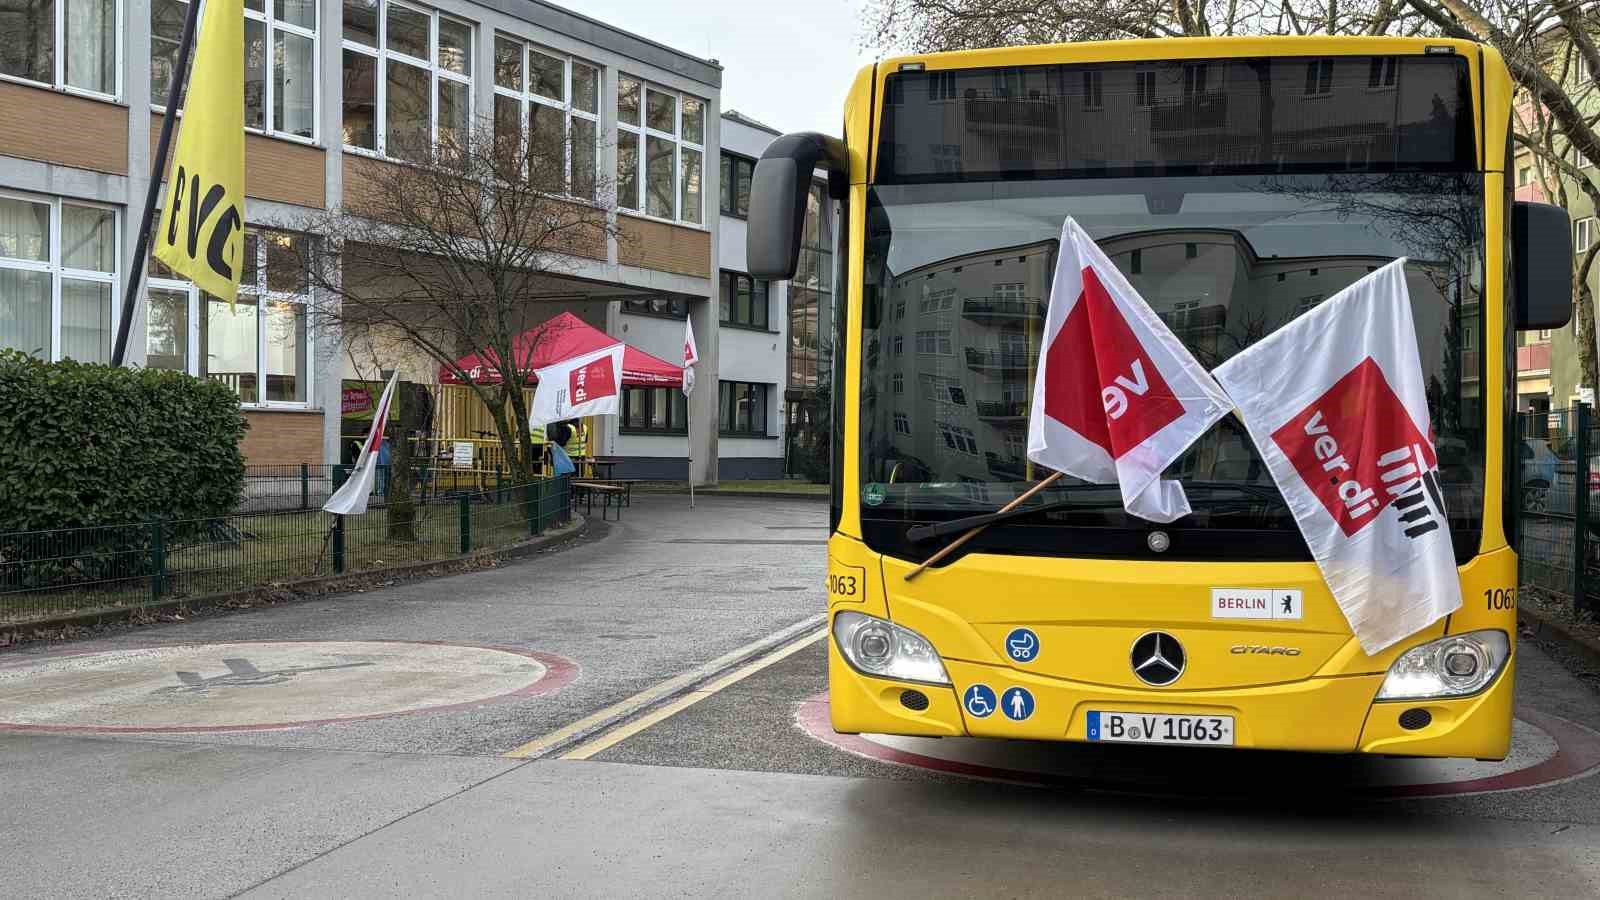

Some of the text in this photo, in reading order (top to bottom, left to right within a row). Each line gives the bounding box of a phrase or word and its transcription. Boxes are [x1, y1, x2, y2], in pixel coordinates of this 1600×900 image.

[1304, 411, 1379, 520] ver.di
[1218, 598, 1266, 609] BERLIN
[1230, 645, 1301, 656] CITARO
[1163, 718, 1222, 741] 1063
